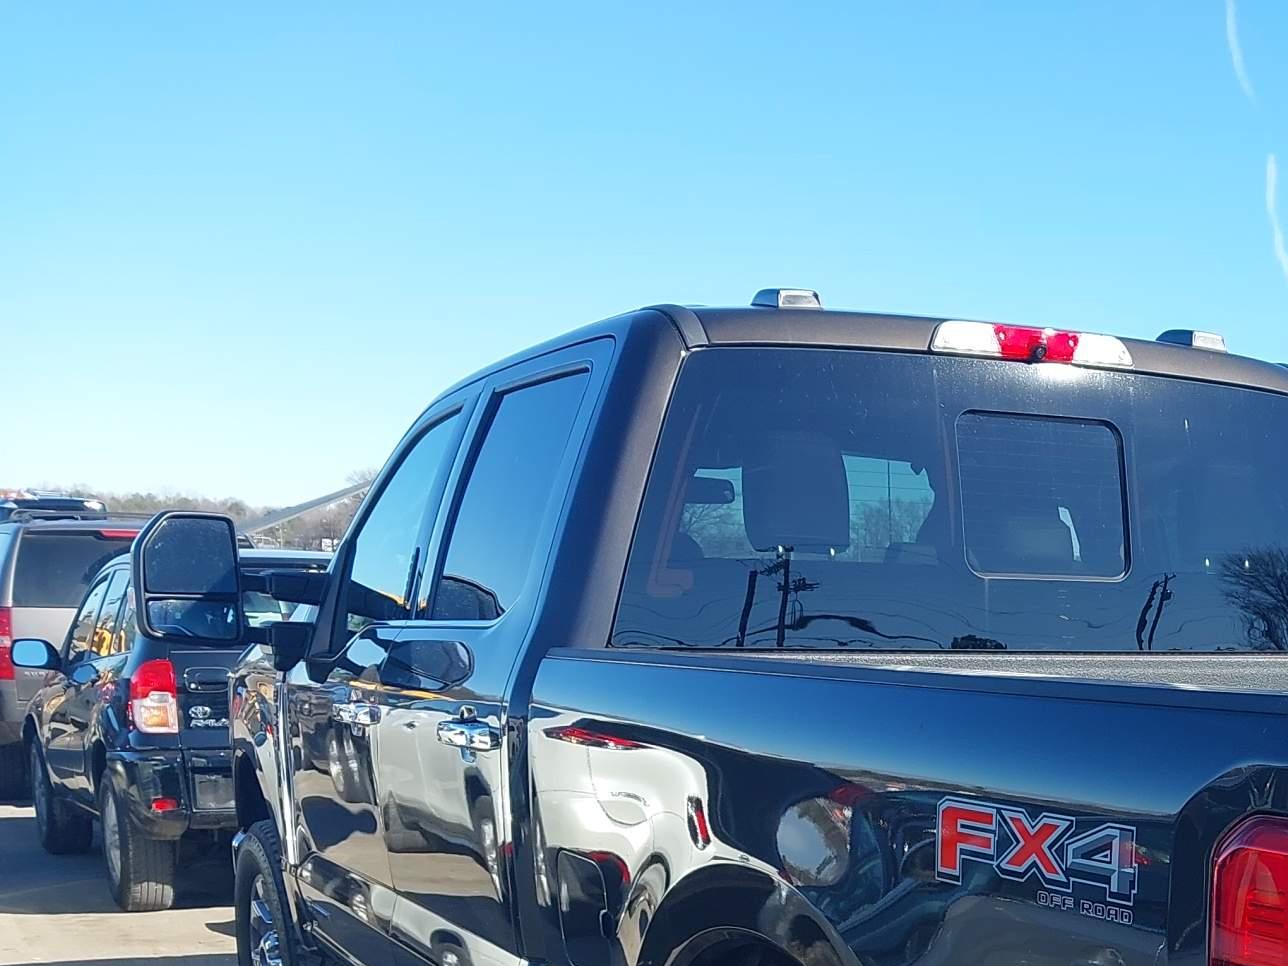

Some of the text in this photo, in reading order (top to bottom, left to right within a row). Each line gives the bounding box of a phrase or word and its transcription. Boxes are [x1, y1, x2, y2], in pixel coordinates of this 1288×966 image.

[935, 795, 1137, 906] FX4
[1036, 890, 1133, 926] OFF ROAD
